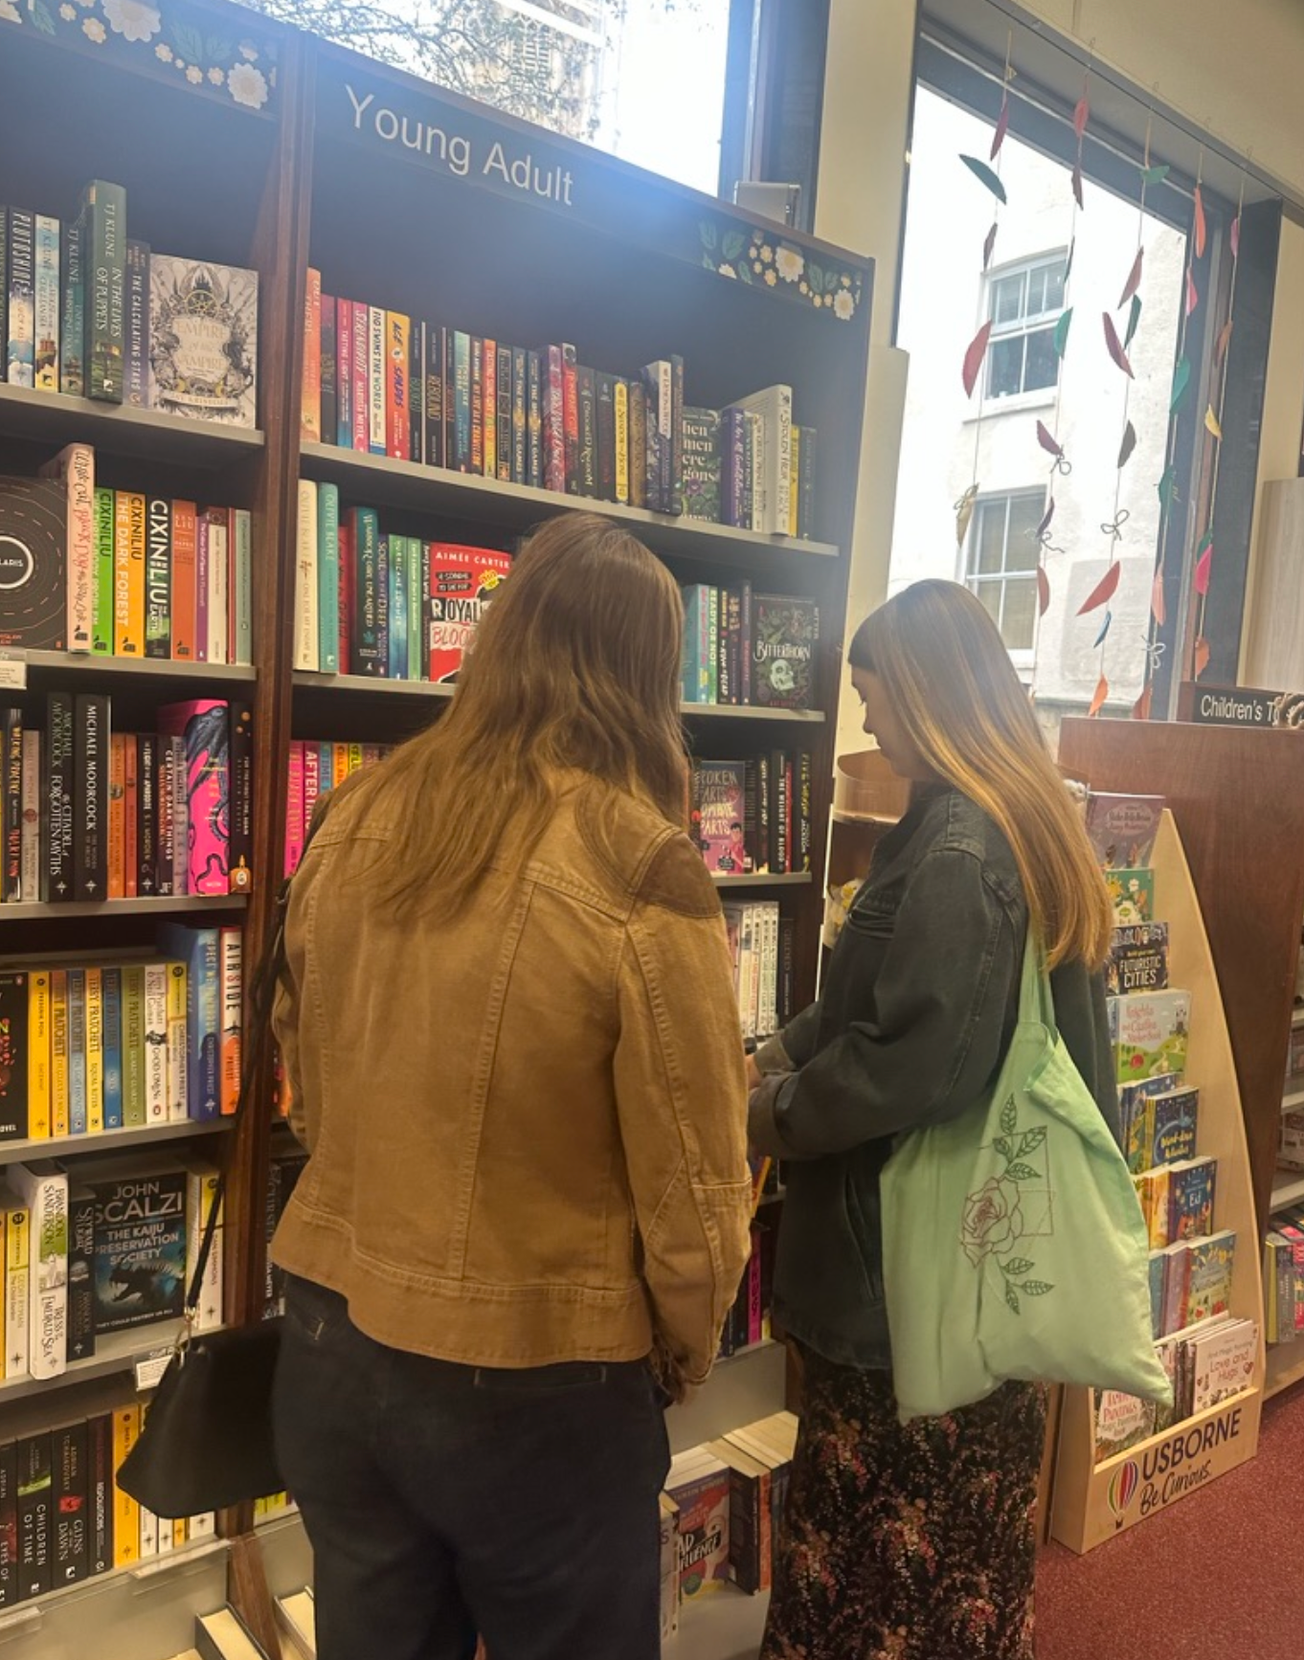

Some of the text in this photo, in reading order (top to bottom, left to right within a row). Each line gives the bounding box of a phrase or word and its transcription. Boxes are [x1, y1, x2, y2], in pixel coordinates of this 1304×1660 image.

[345, 84, 574, 206] Young Adult
[12, 212, 31, 286] PLUTOSHINE
[104, 203, 115, 258] TJ KLUNE
[69, 245, 78, 284] KLUNE
[132, 275, 142, 291] THE
[96, 267, 108, 330] OF PUPPETS
[111, 267, 122, 338] IN THE LIVES
[131, 294, 142, 357] CALCULATING
[177, 320, 227, 339] EMPIRE
[392, 321, 403, 345] ACE
[131, 361, 141, 389] STARS
[177, 355, 227, 370] VAMPIRE
[373, 358, 381, 374] THE
[373, 376, 381, 410] WORLD
[100, 493, 112, 557] CIXIN LIU
[131, 497, 143, 560] CIXIN LIU
[325, 493, 334, 528] OLIVIE
[117, 497, 128, 626] THE DARK FOREST
[149, 500, 169, 604] CIXIN LIU
[325, 531, 334, 561] BLAKE
[474, 556, 510, 569] CARTER
[378, 542, 387, 627] SOUL DEEP
[149, 604, 158, 632] EARTH
[709, 590, 717, 666] READY OR NOT
[1201, 694, 1263, 722] Children's
[51, 701, 62, 768] MOORCOCK
[63, 711, 72, 756] MICHAEL
[86, 705, 97, 831] MICHAEL MOORCOCK
[305, 751, 318, 796] AFTER
[48, 775, 62, 876] FORGOTTEN MYTHS
[62, 805, 72, 847] CITADEL
[165, 750, 173, 861] CERTAIN DARK THINGS
[226, 944, 239, 1011] AIRSIDE
[1120, 955, 1161, 973] FUTURISTIC
[1124, 969, 1157, 988] CITIES
[54, 1007, 65, 1057] PRATCHETT
[72, 1006, 82, 1052] PRATCHETT
[89, 977, 99, 1053] TERRY PRATCHETT
[129, 1002, 139, 1049] PRATCHETT
[206, 1076, 215, 1095] PRIEST
[55, 1188, 65, 1237] BRANDON
[95, 1191, 183, 1224] SCALZI
[113, 1181, 160, 1200] JOHN
[43, 1185, 55, 1245] SANDERSON
[107, 1223, 165, 1241] THE KAIJU
[110, 1247, 162, 1265] SOCIETY
[42, 1296, 55, 1358] EMERALD SEA
[54, 1306, 64, 1331] TRESS
[111, 1318, 130, 1326] COULD
[131, 1313, 154, 1323] DESTROY
[1210, 1348, 1249, 1373] Love and
[1217, 1366, 1239, 1382] Hugs
[1142, 1408, 1242, 1481] USBORNE
[1140, 1459, 1211, 1515] Be Curious
[23, 1514, 33, 1564] OF TIME
[36, 1504, 46, 1566] CHILDREN
[58, 1521, 69, 1561] DAWN
[73, 1519, 84, 1554] GUNS
